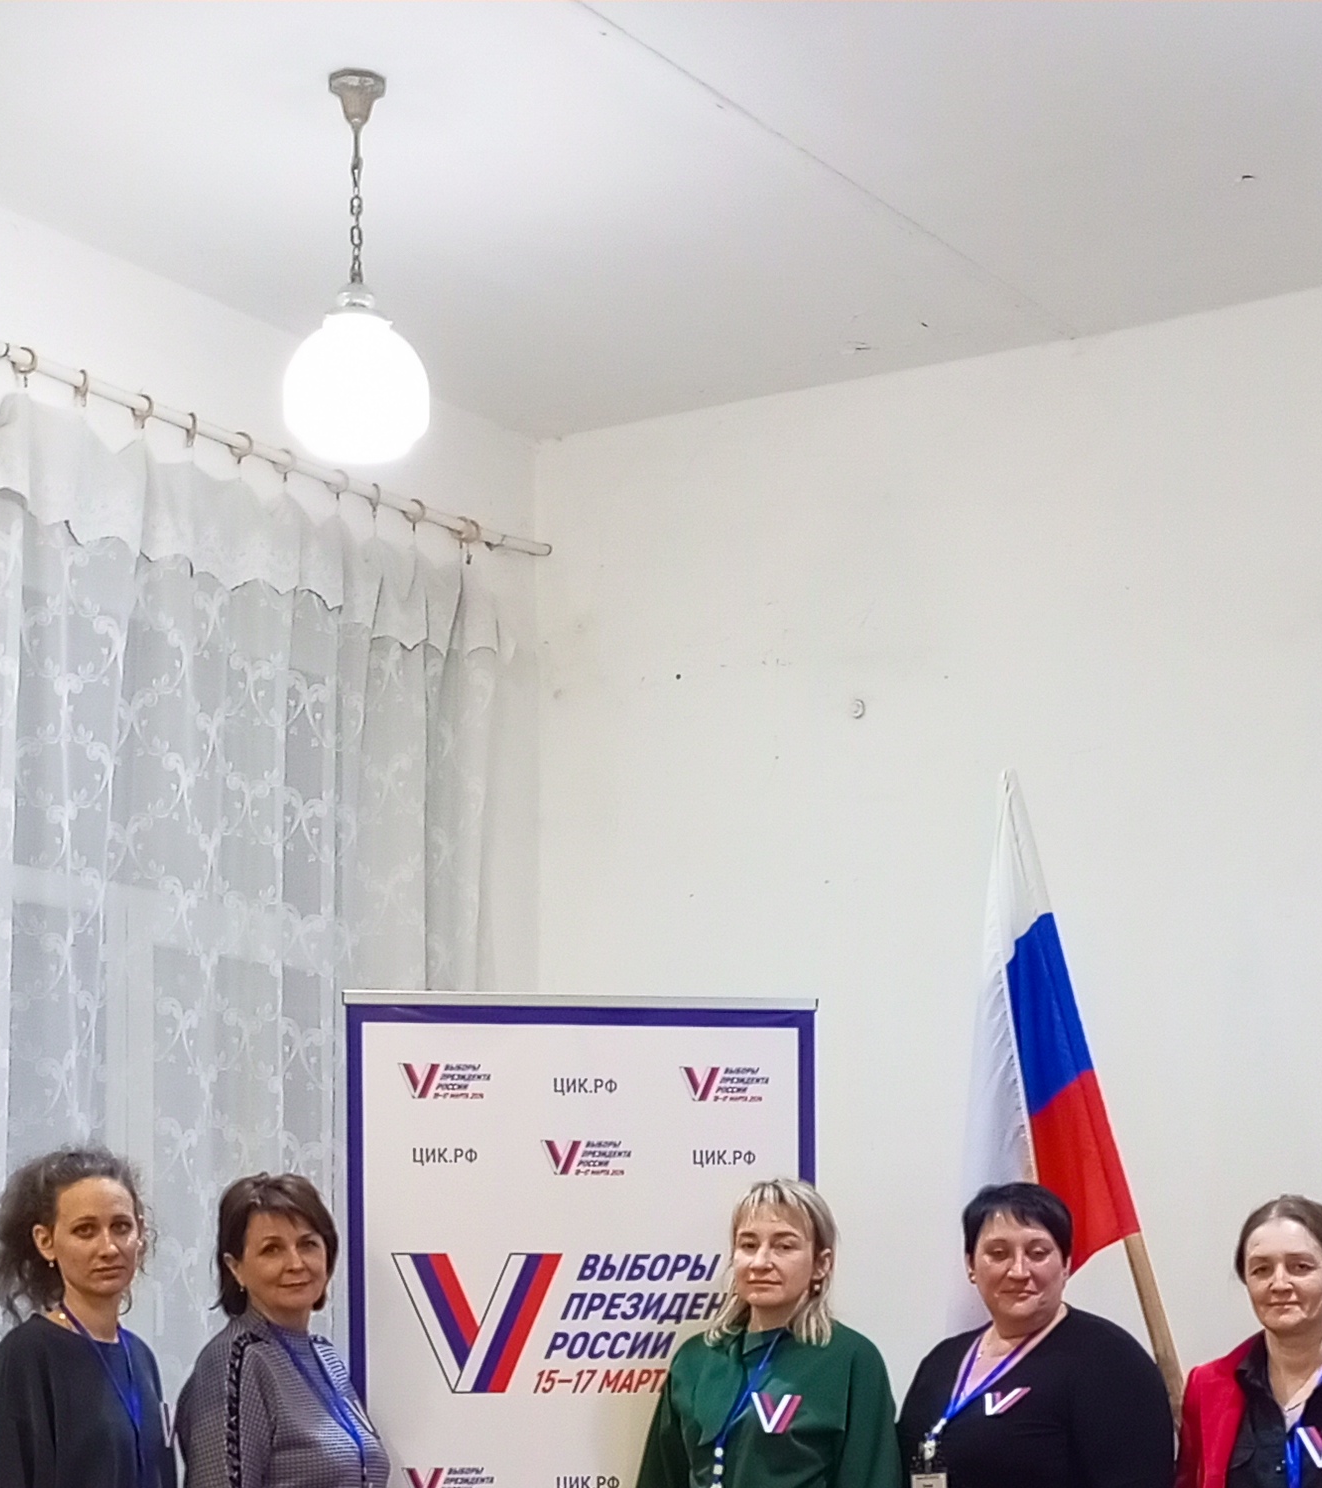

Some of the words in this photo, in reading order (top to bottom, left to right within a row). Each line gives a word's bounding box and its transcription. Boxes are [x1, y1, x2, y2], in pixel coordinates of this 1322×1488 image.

[553, 1077, 618, 1096] ЦИК.РФ
[412, 1147, 478, 1167] ЦИК.РФ
[581, 1150, 631, 1158] ПРЕЗИДЕНТА
[692, 1149, 756, 1168] ЦИК.РФ
[576, 1253, 721, 1281] ВЫБОРЫ
[560, 1292, 728, 1324] ПРЕЗИДЕН
[544, 1331, 676, 1360] РОССИИ
[598, 1369, 665, 1394] МАРТ
[443, 1476, 494, 1485] ПРЕЗИДЕНТА
[448, 1467, 484, 1475] ВЫБОРЫ
